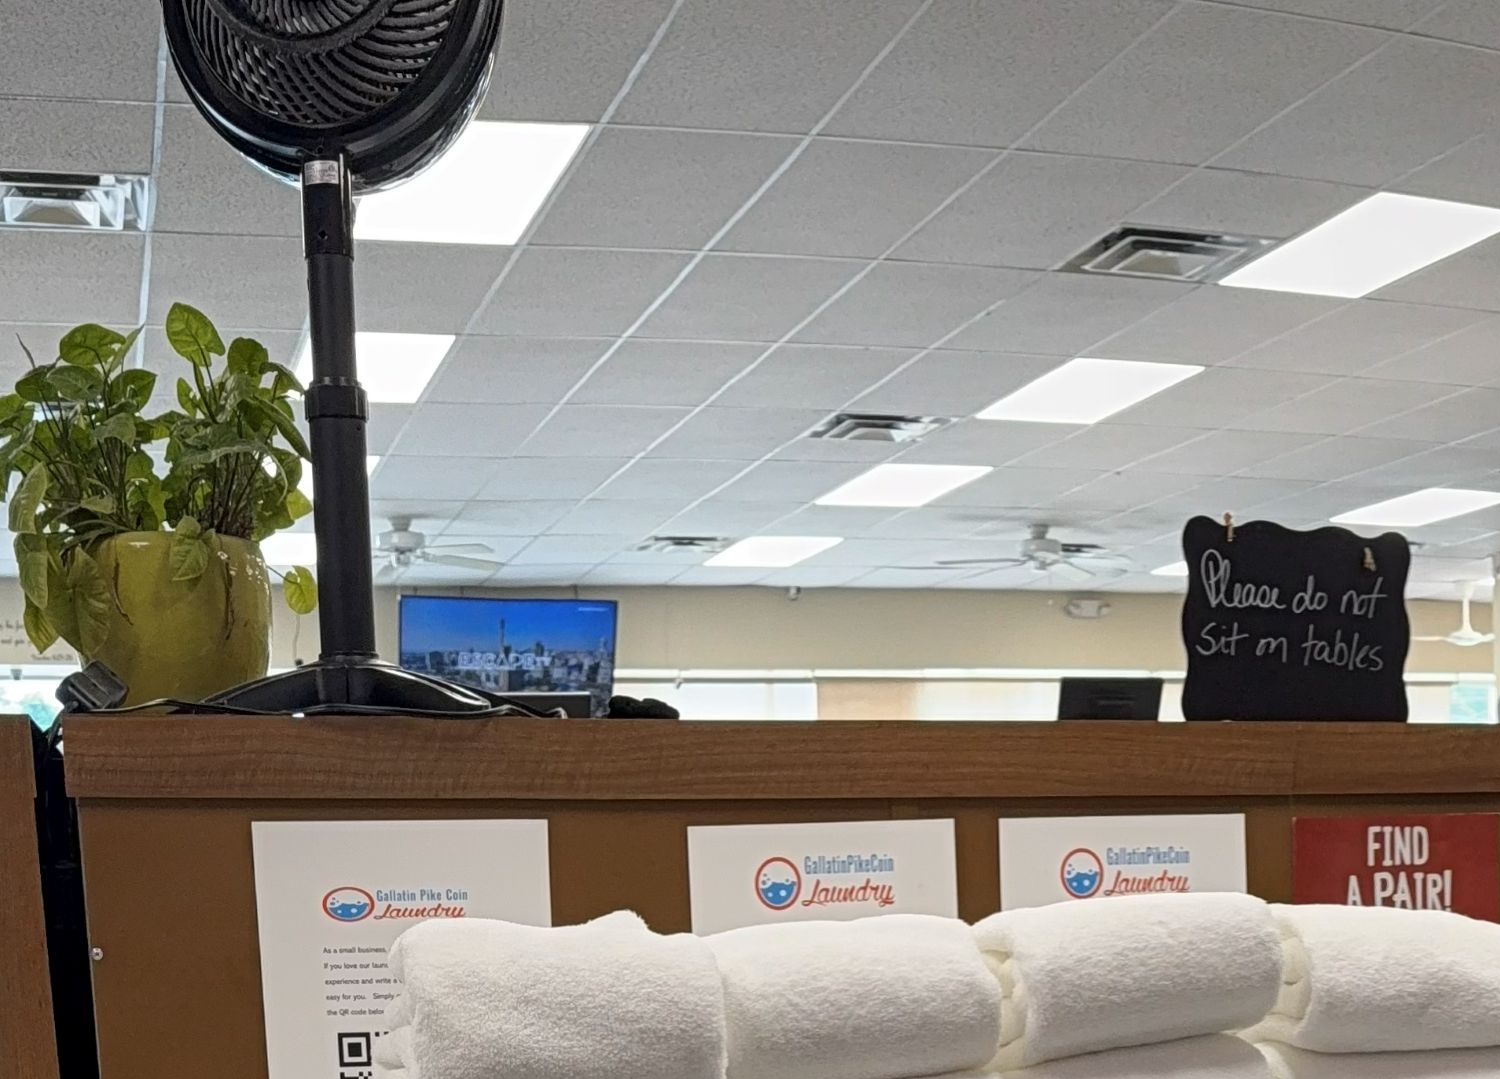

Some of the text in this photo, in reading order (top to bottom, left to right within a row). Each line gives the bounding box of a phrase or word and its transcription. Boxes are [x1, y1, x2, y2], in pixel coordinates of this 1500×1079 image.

[1201, 548, 1388, 619] Please do not
[1256, 637, 1288, 663] on
[1301, 624, 1383, 671] tables
[1367, 826, 1429, 866] FIND
[376, 888, 468, 902] Gallatin Pike Coin
[801, 879, 895, 907] Laundry
[1104, 870, 1191, 895] Laundry
[1347, 869, 1452, 912] A PAIR!
[373, 903, 466, 919] Laundry
[329, 963, 342, 971] you
[326, 994, 340, 1002] easy
[373, 993, 394, 1001] Simply
